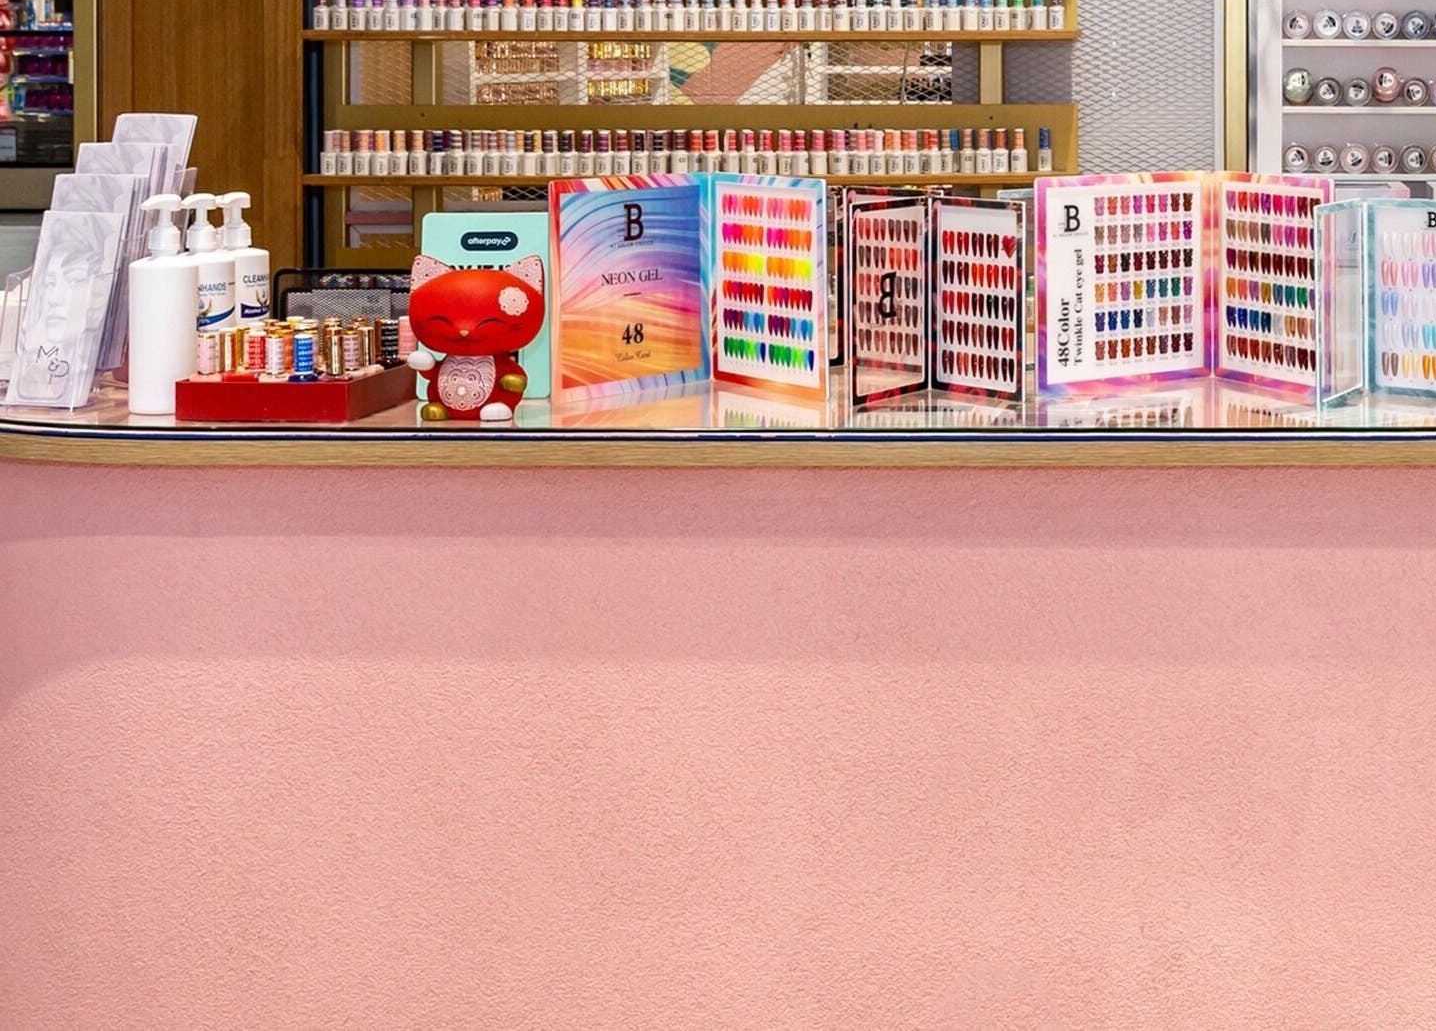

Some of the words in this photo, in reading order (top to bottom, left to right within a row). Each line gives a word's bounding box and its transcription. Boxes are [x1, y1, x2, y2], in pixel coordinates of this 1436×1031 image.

[624, 204, 644, 241] B
[1064, 204, 1081, 232] B
[467, 236, 501, 246] afterpay
[1074, 249, 1085, 267] gel
[601, 271, 636, 286] NEON
[638, 268, 663, 284] GEL
[1076, 271, 1085, 290] eye
[1074, 292, 1084, 314] Cat
[622, 323, 644, 345] 48
[1057, 298, 1071, 367] 48Color
[1074, 315, 1084, 366] Twinkle
